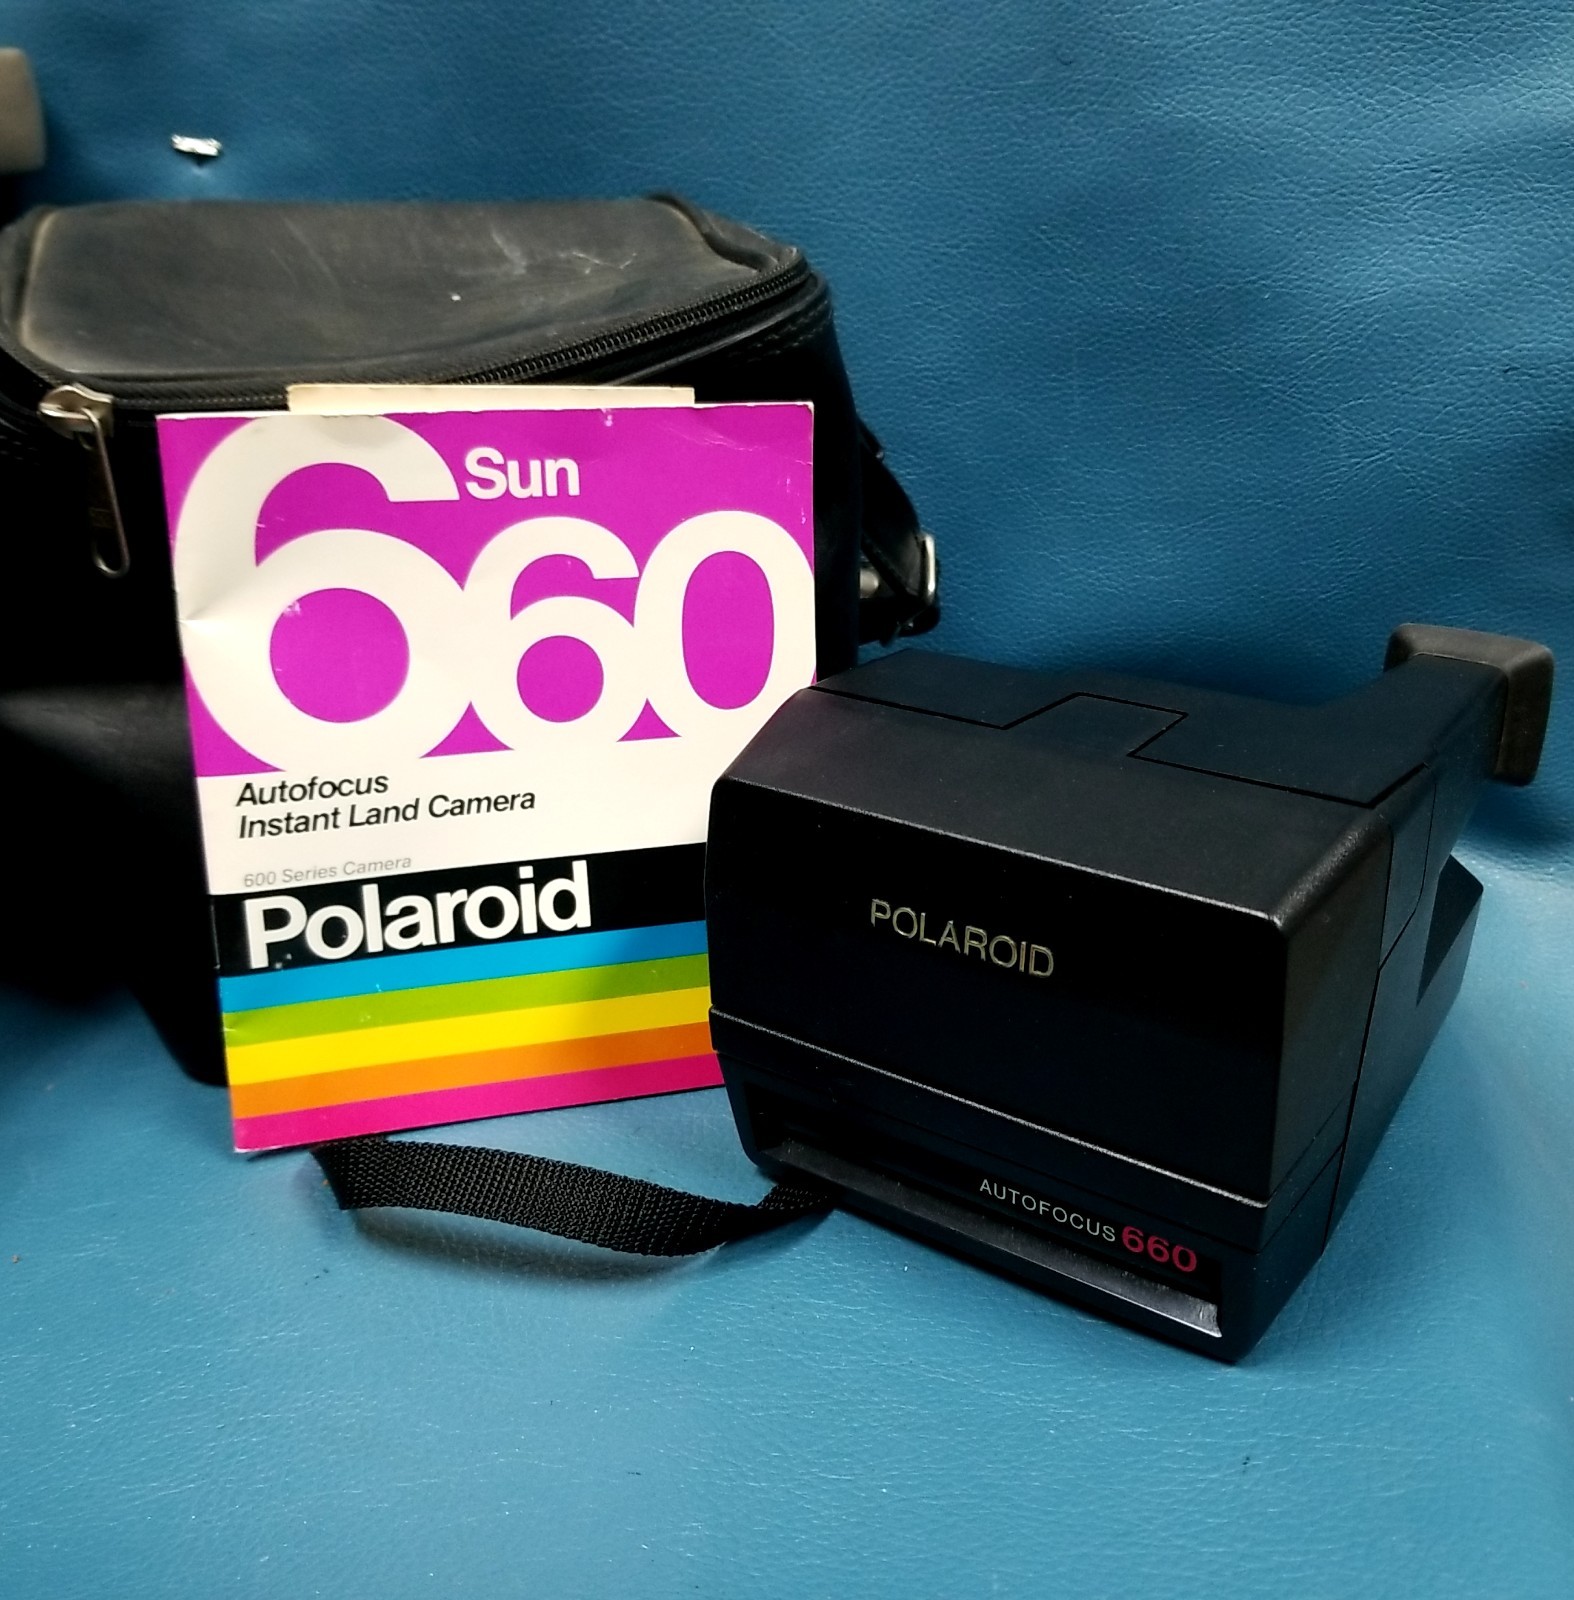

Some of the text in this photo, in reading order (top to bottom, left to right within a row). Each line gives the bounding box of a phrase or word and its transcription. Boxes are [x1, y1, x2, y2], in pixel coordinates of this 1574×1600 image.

[465, 447, 580, 499] Sun
[173, 413, 817, 774] 660
[236, 775, 389, 807] Autofocus
[239, 790, 536, 838] Instant Land Camera
[243, 856, 412, 888] 600 Series Camera
[244, 859, 592, 969] Polaroid
[870, 898, 1054, 978] POLAROID
[979, 1179, 1198, 1273] AUTOFOCUS 660
